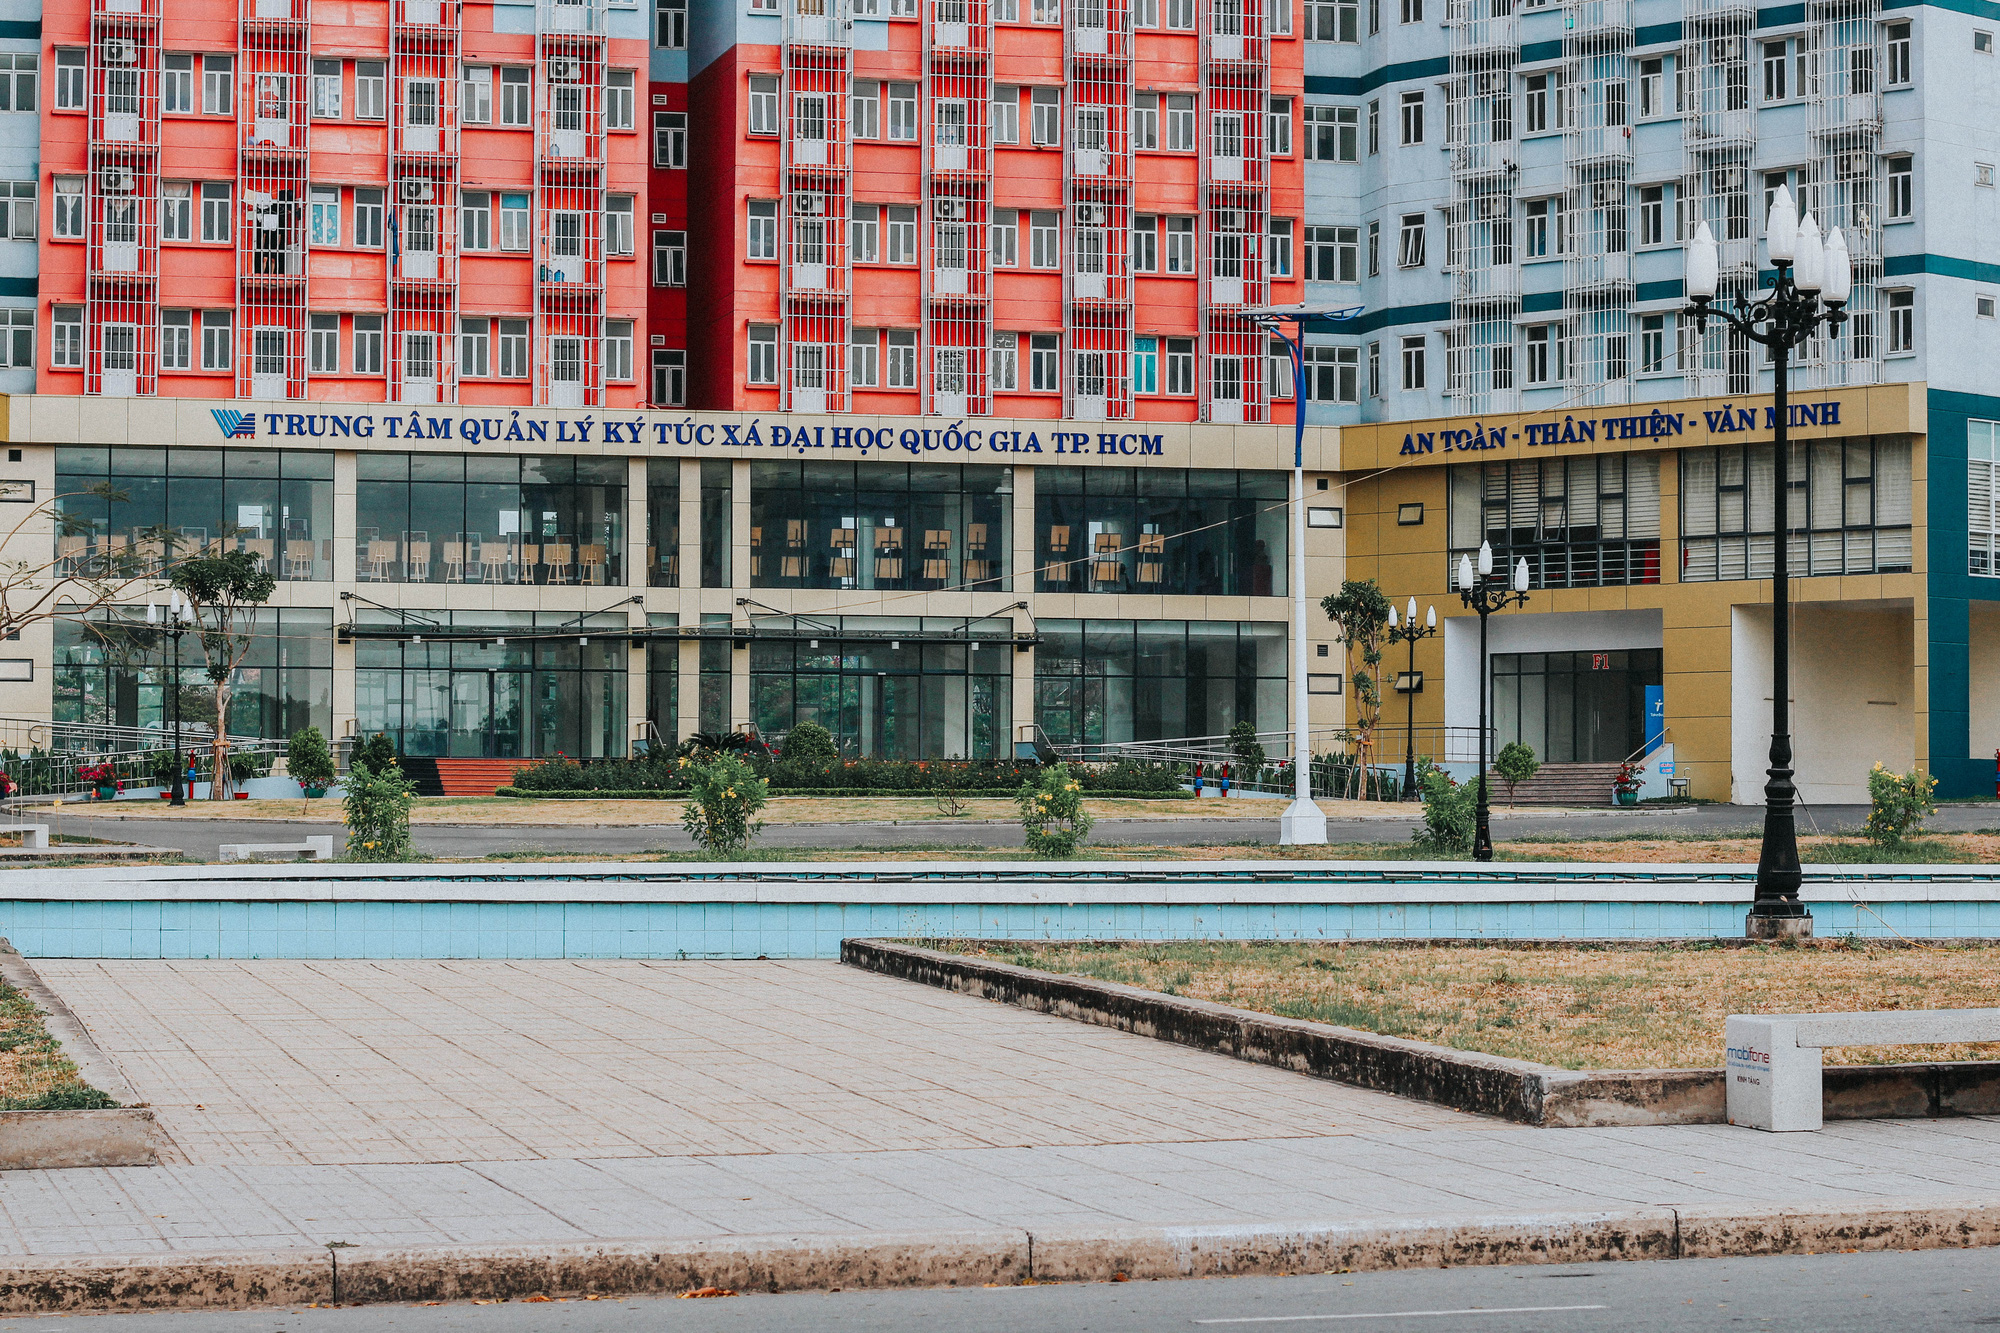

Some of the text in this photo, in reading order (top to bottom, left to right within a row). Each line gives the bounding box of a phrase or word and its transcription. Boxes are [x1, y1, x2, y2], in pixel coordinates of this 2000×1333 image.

[264, 410, 1164, 456] TRUNG TÂM QUẢN LÝ KÝ TÚC XÁ ĐẠI HỌC QUỐC GIA TP. HCM
[1399, 432, 1435, 455] AN
[1440, 422, 1507, 452] TOÀN
[1525, 415, 1597, 446] THÂN
[1603, 409, 1684, 443] THIỆN
[1704, 404, 1757, 433] VĂN
[1592, 653, 1610, 670] F1
[1727, 1046, 1770, 1064] mobifone
